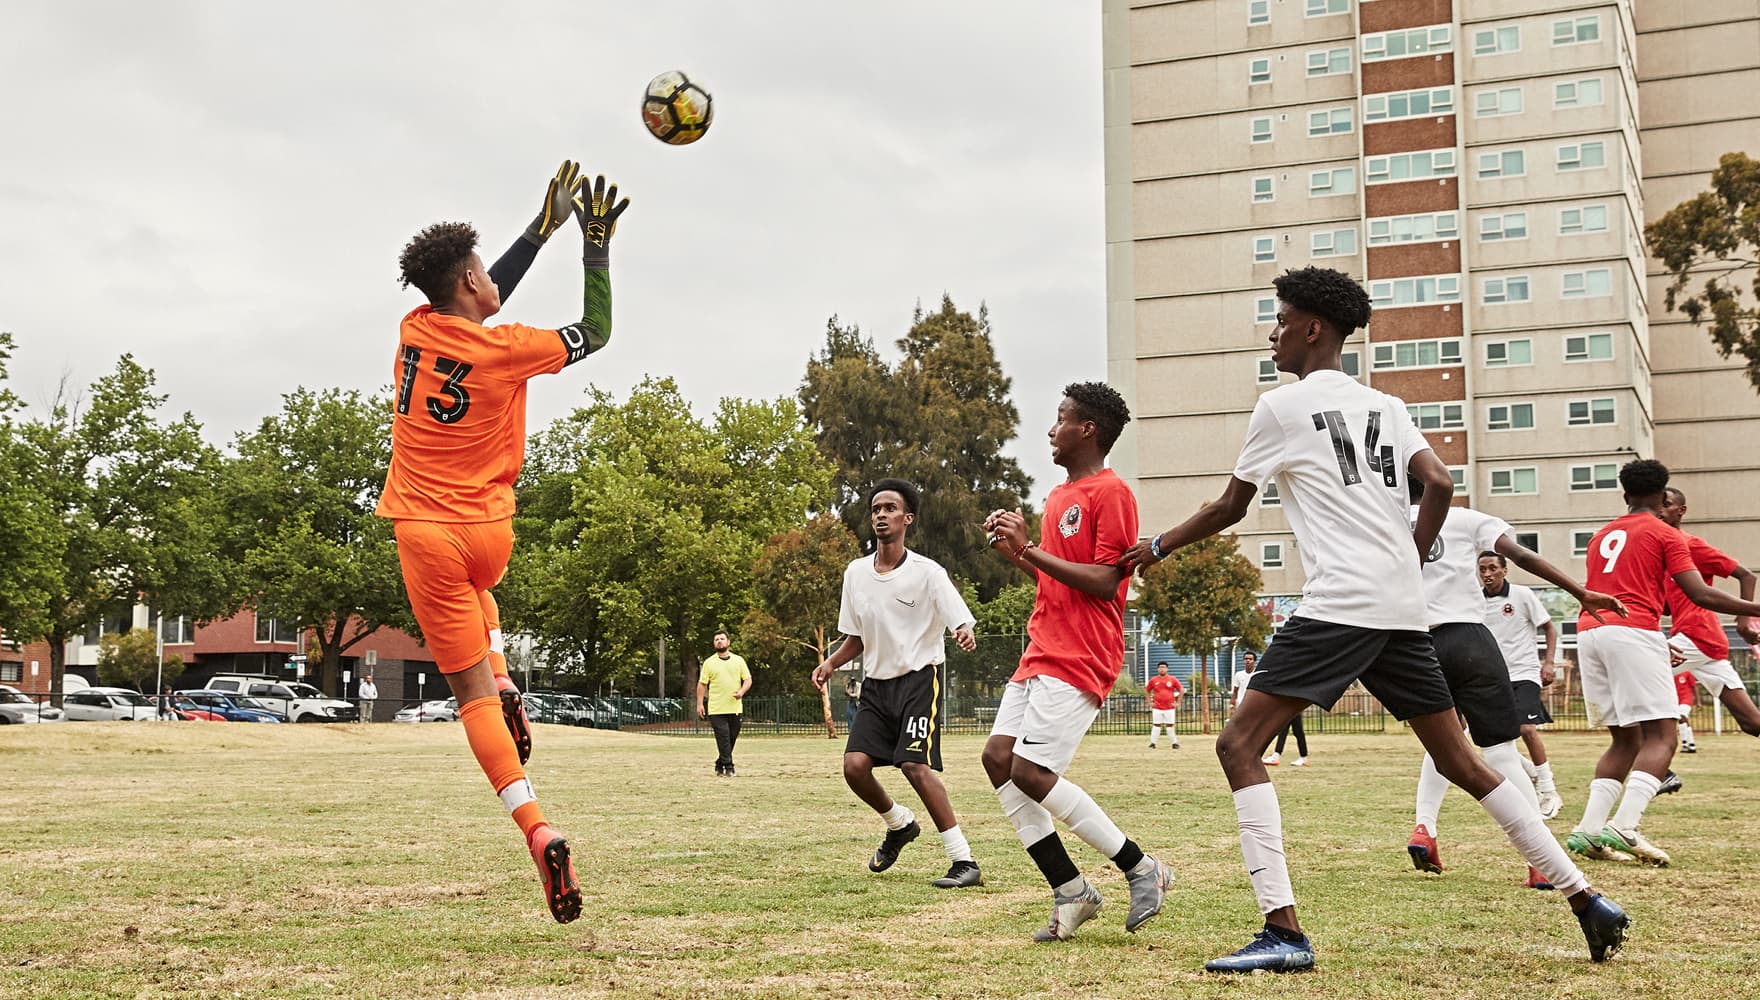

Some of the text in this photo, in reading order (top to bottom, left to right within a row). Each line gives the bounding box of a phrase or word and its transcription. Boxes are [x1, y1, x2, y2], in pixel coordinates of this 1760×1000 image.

[398, 344, 473, 424] 13
[1312, 410, 1397, 487] 14
[1600, 530, 1627, 573] 9
[906, 716, 928, 738] 49
